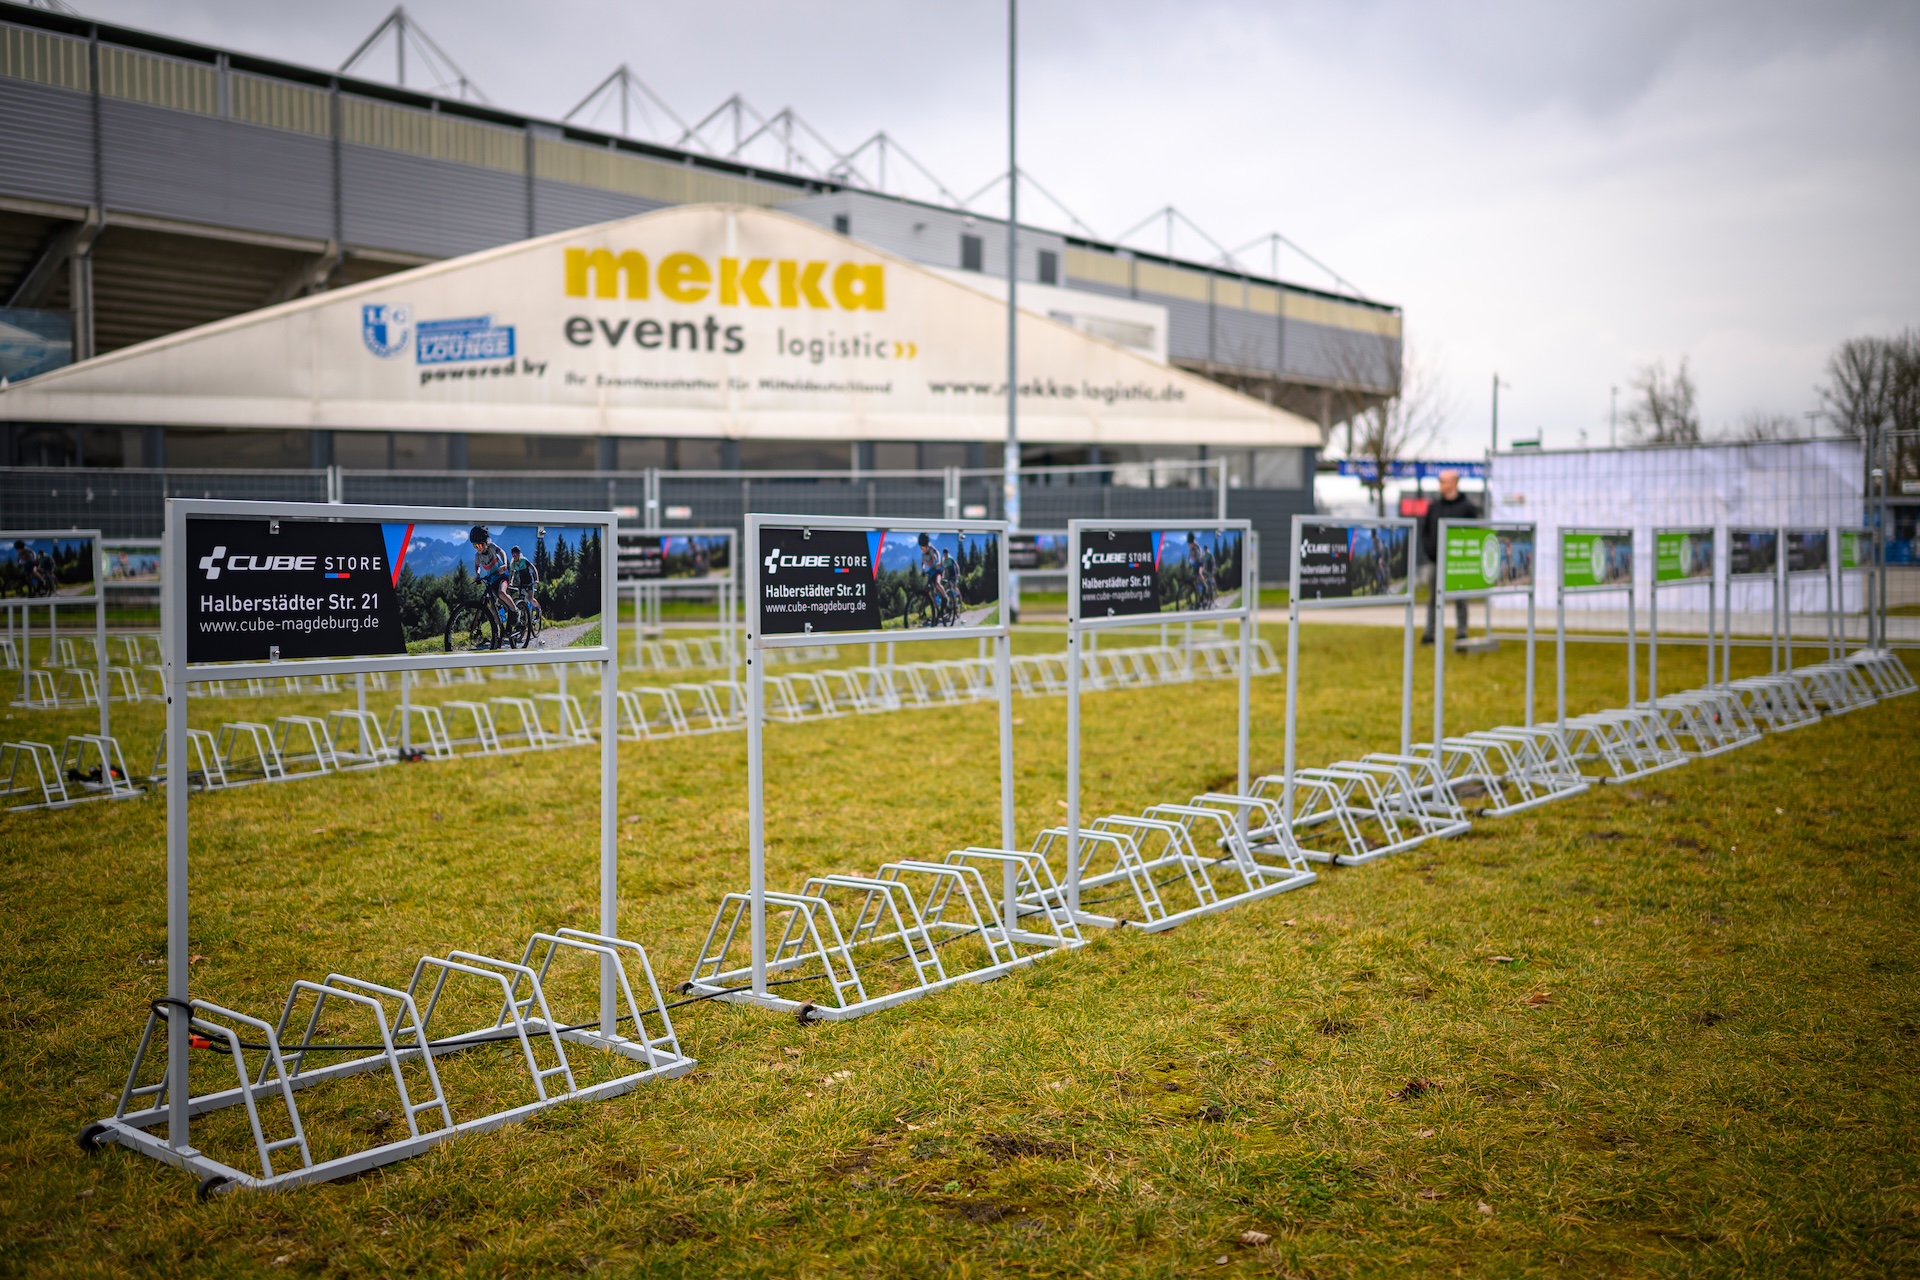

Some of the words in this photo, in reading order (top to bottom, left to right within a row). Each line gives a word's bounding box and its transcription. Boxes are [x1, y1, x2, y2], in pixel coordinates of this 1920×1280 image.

[564, 247, 887, 312] mekka
[565, 315, 745, 354] events
[420, 338, 509, 360] LOUNGE
[778, 328, 889, 364] logistic
[420, 359, 516, 387] powered
[523, 357, 548, 376] by
[227, 556, 317, 571] CUBE
[324, 557, 382, 571] STORE
[780, 555, 831, 568] CUBE
[834, 555, 868, 567] STORE
[1092, 552, 1127, 564] CUBE
[1128, 552, 1152, 563] STORE
[1082, 576, 1128, 589] Halberstädter
[1129, 575, 1142, 588] Str.
[1142, 574, 1151, 587] 21
[766, 584, 834, 598] Halberstädter
[837, 583, 854, 597] Str.
[855, 583, 867, 596] 21
[1081, 590, 1151, 602] www.cube-magdeburg.de
[201, 594, 324, 612] Halberstädter
[328, 593, 356, 610] Str.
[361, 592, 379, 609] 21
[765, 600, 867, 613] www.cube-magdeburg.de
[200, 614, 379, 634] www.cube-magdeburg.de
